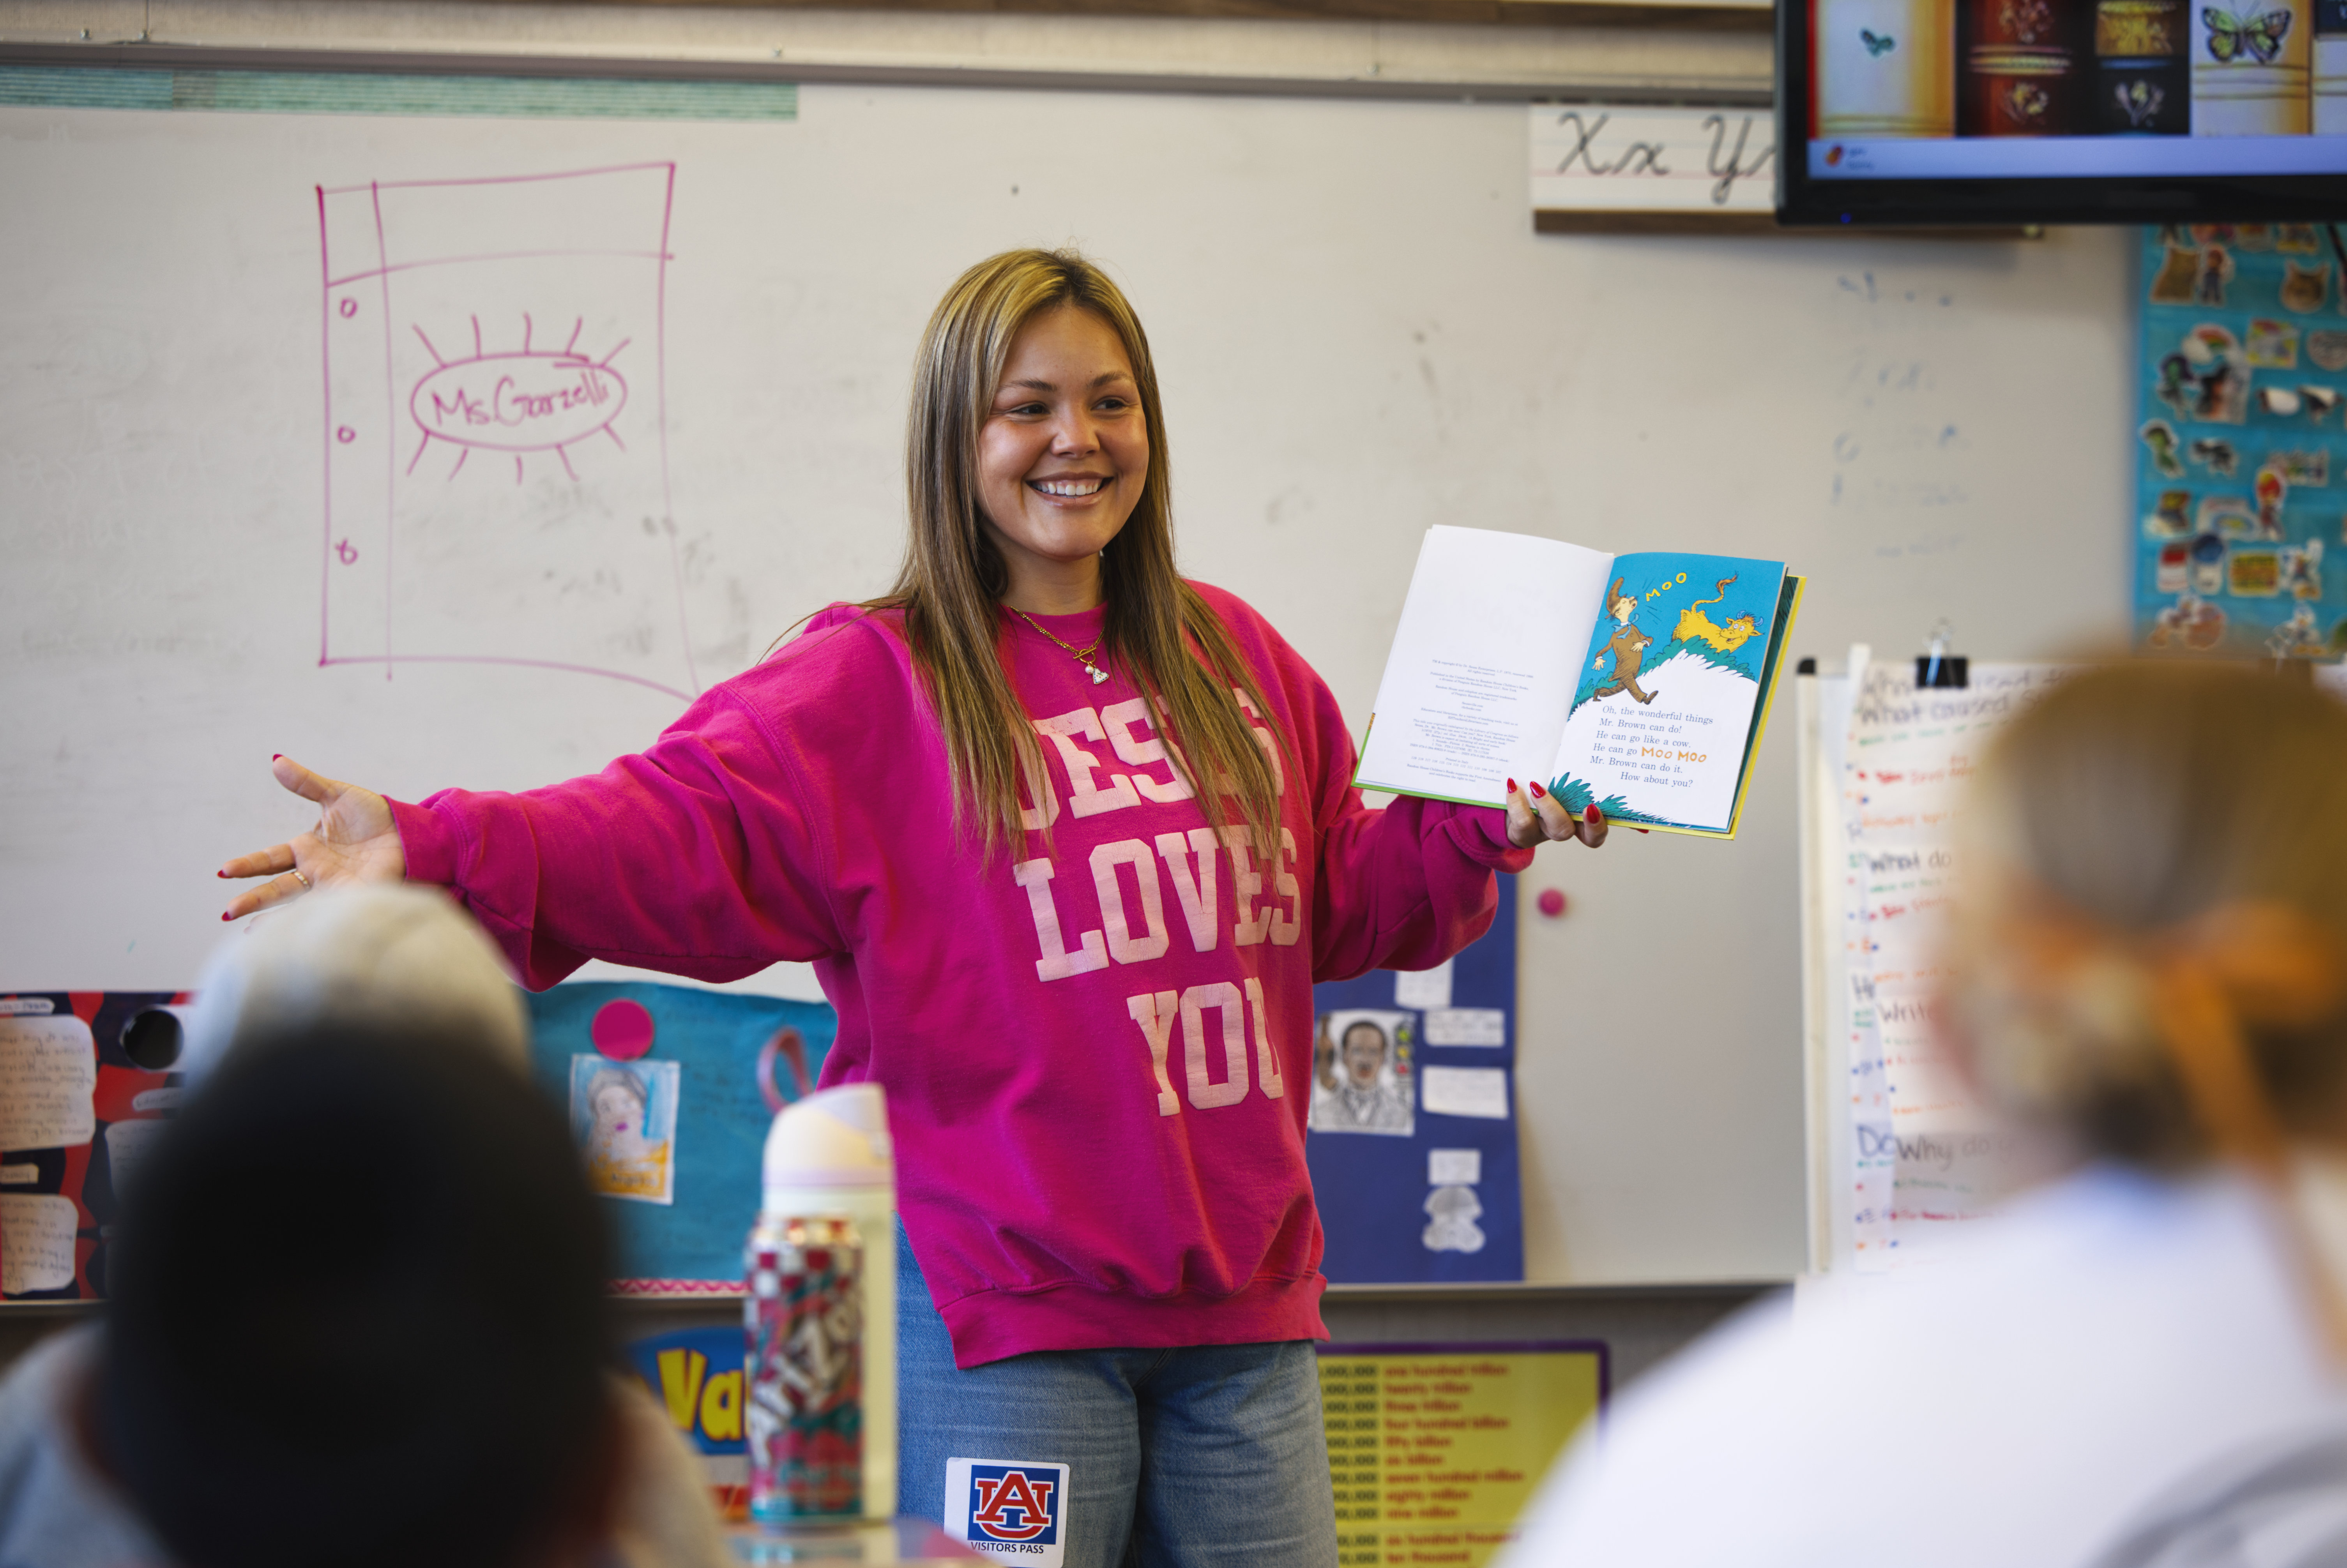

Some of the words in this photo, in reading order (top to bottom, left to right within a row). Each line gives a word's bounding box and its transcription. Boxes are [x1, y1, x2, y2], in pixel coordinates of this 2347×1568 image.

[1557, 111, 1671, 175] Xx
[1645, 572, 1687, 602] MOO
[1603, 706, 1617, 716] Oh,
[1621, 707, 1635, 715] the
[1638, 708, 1682, 721] wonderful
[1686, 713, 1713, 725] things
[1618, 719, 1645, 730] Brown
[1649, 724, 1665, 732] can
[1668, 724, 1682, 733] do!
[1596, 731, 1608, 739] He
[1644, 735, 1660, 744] like
[1590, 756, 1604, 765] Mr.
[1609, 758, 1637, 768] Brown
[1660, 763, 1670, 772] do
[1674, 765, 1683, 773] it.
[1621, 772, 1640, 781] How
[1644, 775, 1669, 785] about
[1671, 778, 1693, 788] you?
[1014, 824, 1302, 982] LOVES
[657, 1348, 750, 1441] Va
[971, 1542, 1017, 1553] VISITORS
[1020, 1544, 1044, 1554] PASS
